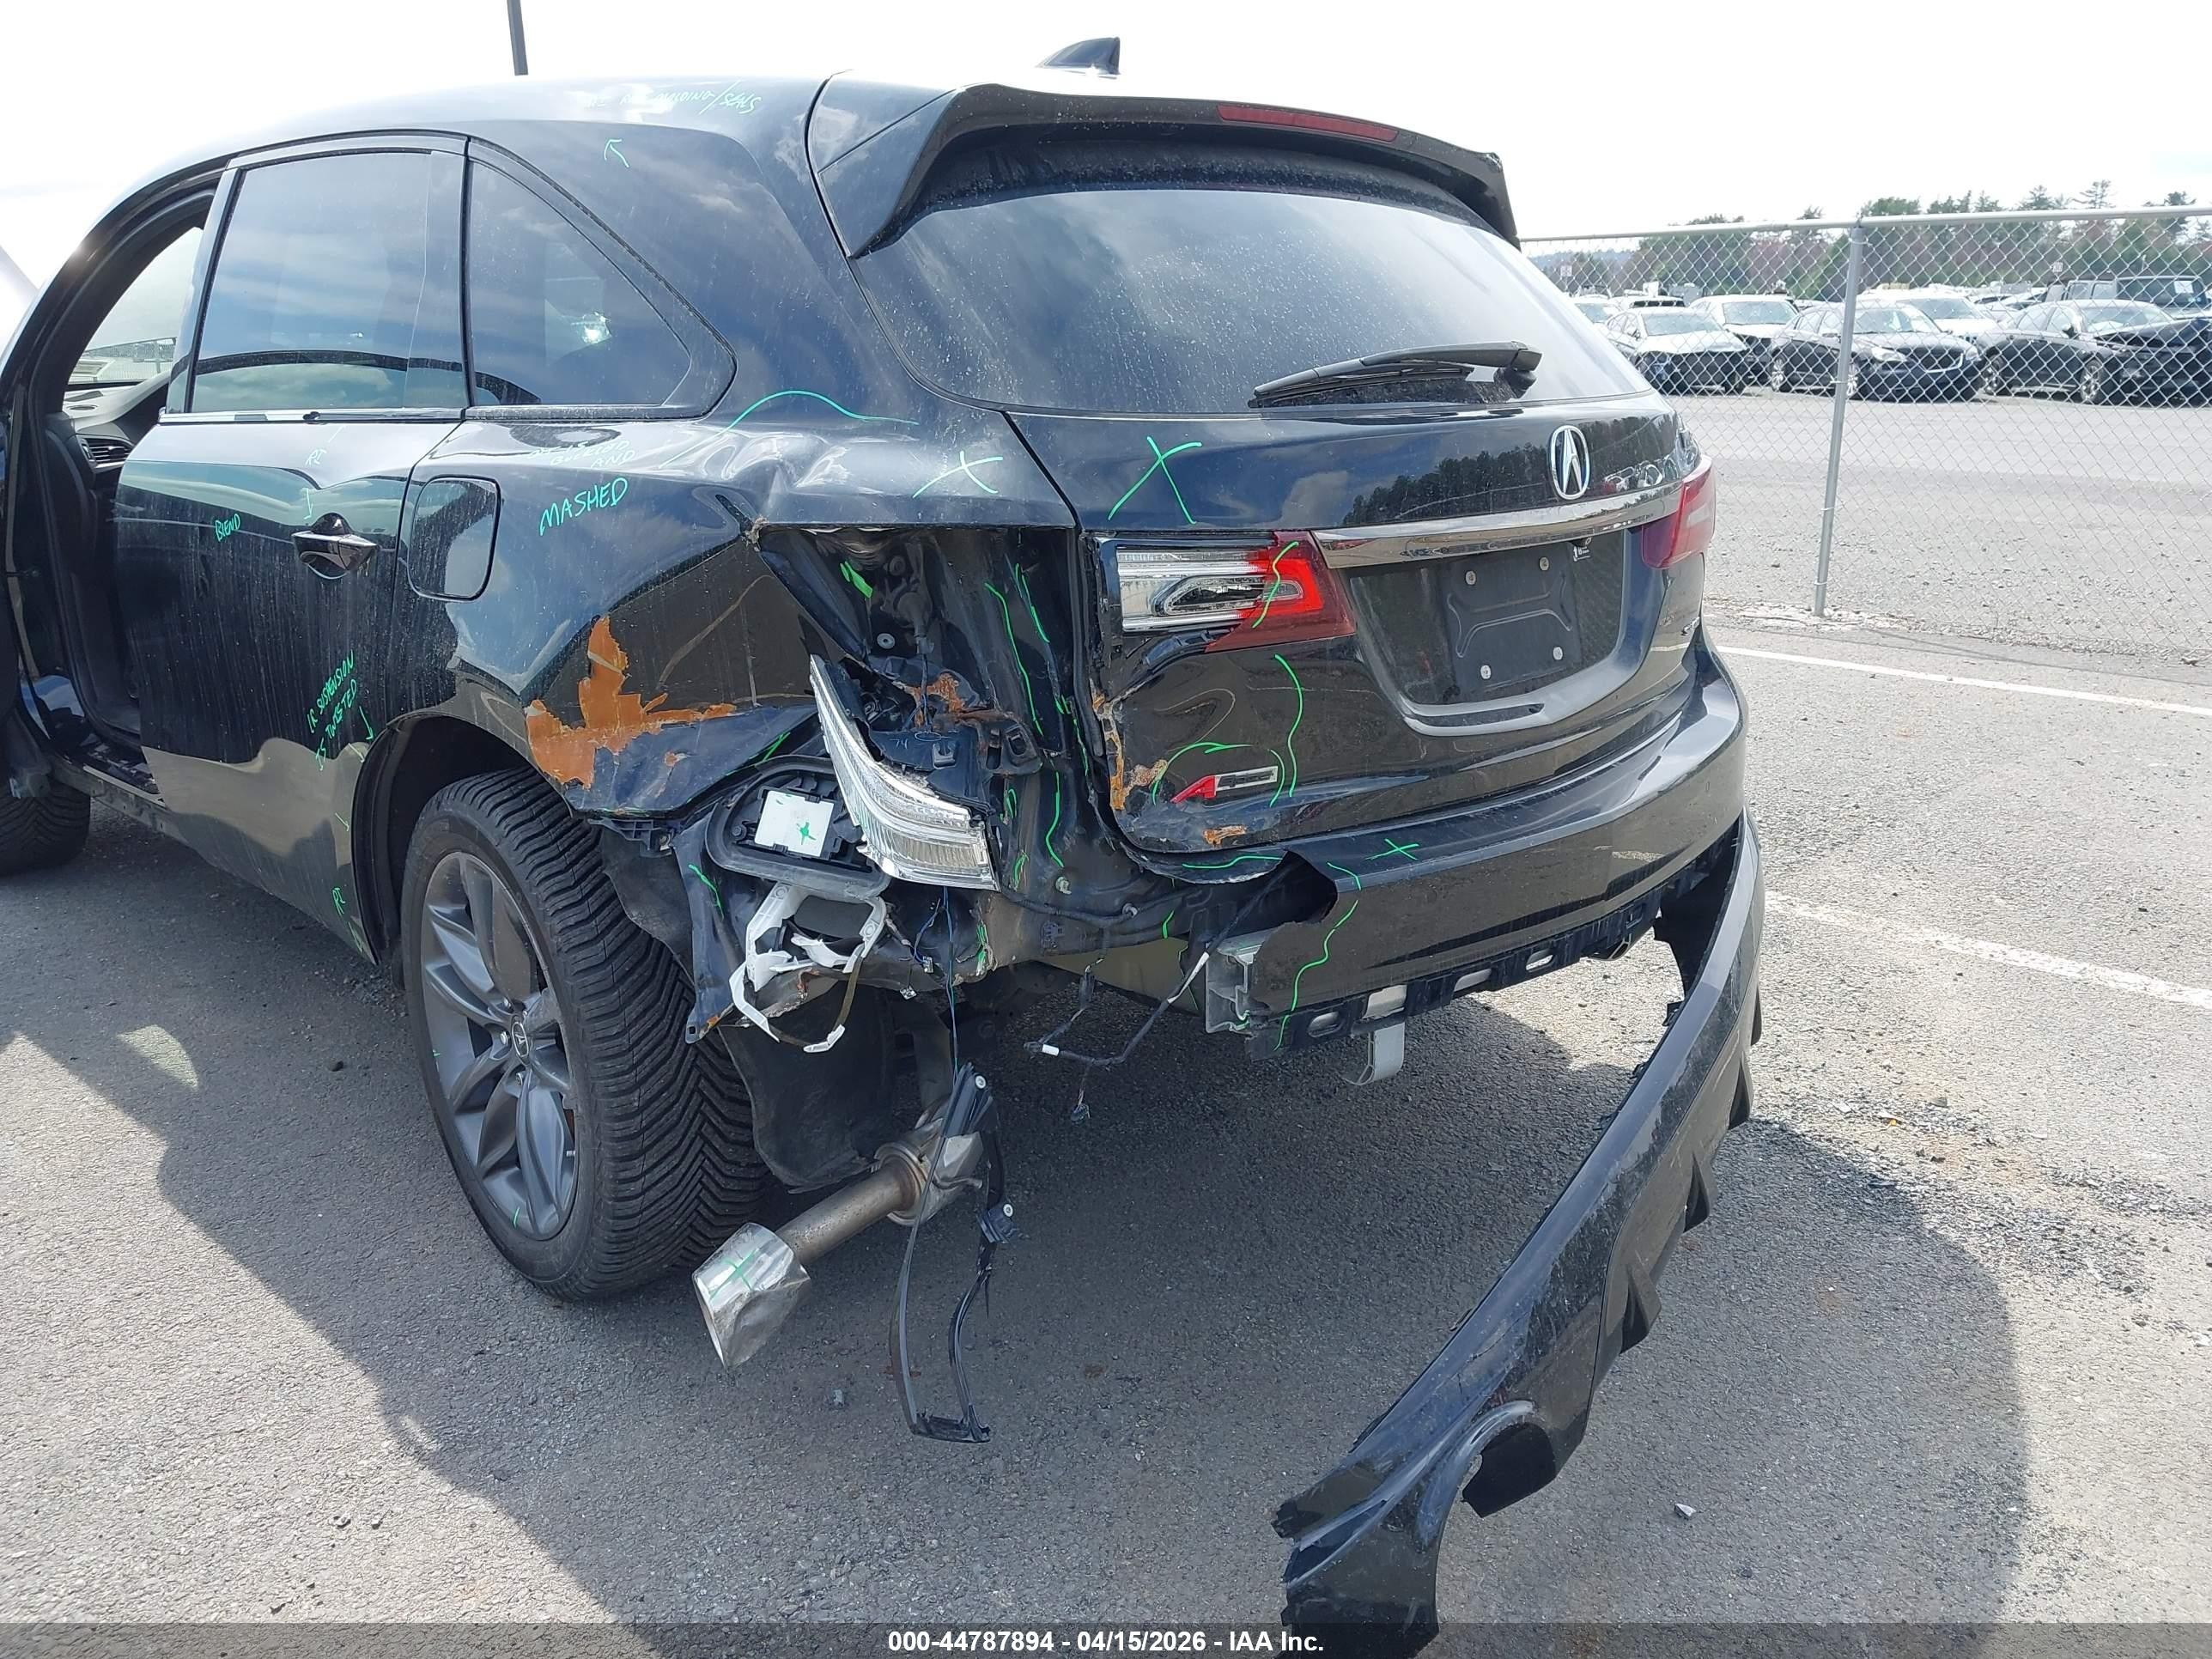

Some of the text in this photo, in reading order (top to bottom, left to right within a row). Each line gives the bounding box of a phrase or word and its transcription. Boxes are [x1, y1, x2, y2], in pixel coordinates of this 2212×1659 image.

[216, 514, 240, 541] BLEND
[539, 477, 628, 536] MASHED
[317, 649, 354, 714] SUSPENSION
[325, 679, 356, 738] TWISTED
